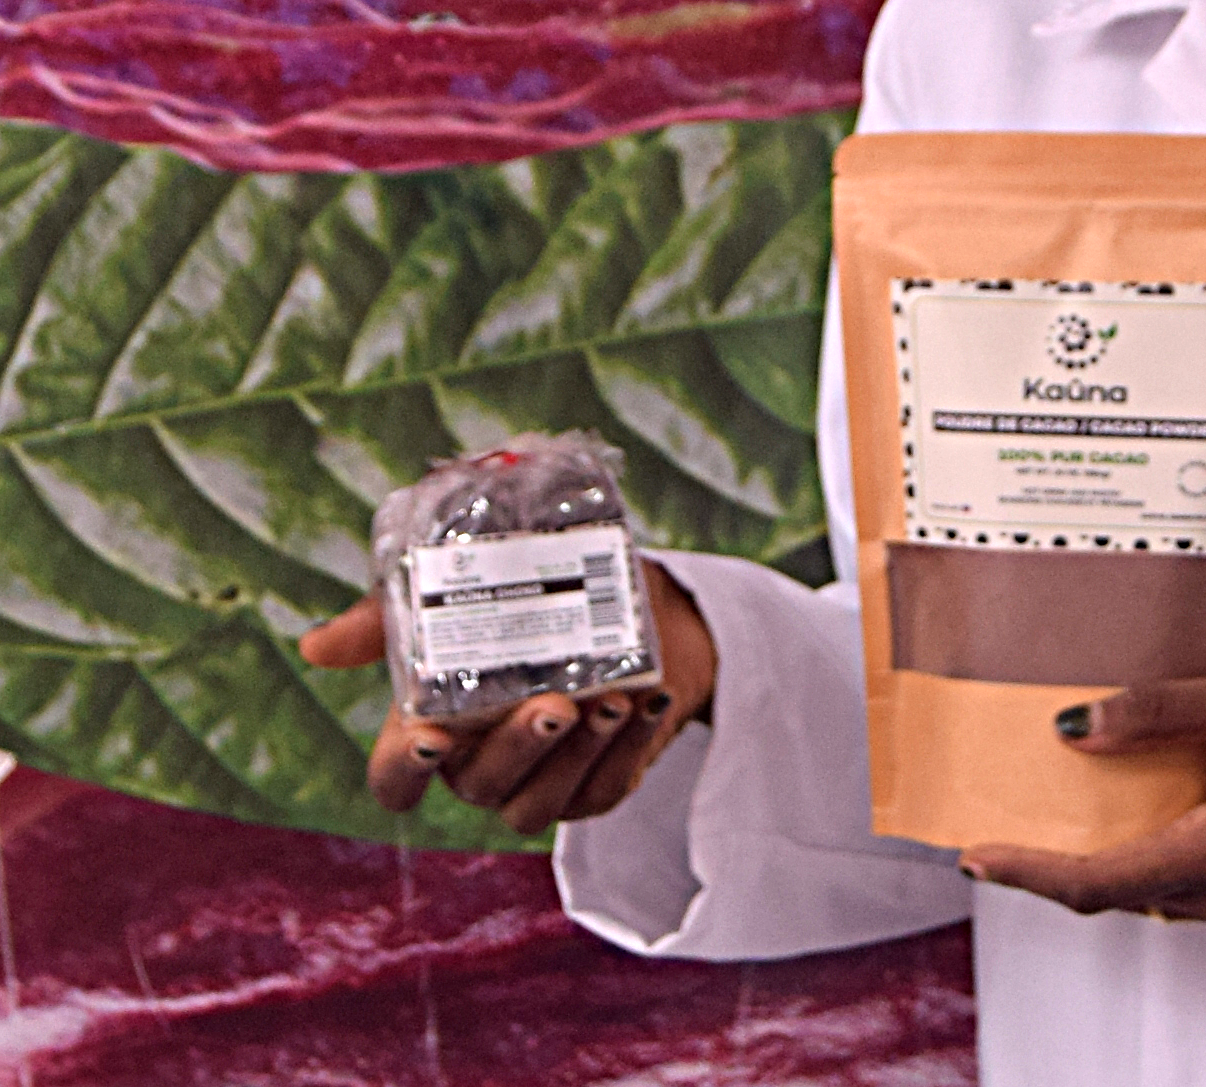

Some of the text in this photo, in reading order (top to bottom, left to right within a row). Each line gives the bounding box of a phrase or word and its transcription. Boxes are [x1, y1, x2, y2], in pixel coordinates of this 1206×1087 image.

[1022, 377, 1128, 403] Kaûna
[997, 415, 1016, 431] DE
[1020, 416, 1077, 433] CACAO
[1089, 418, 1146, 435] CACAO
[998, 448, 1149, 465] 100% PUR CACAO
